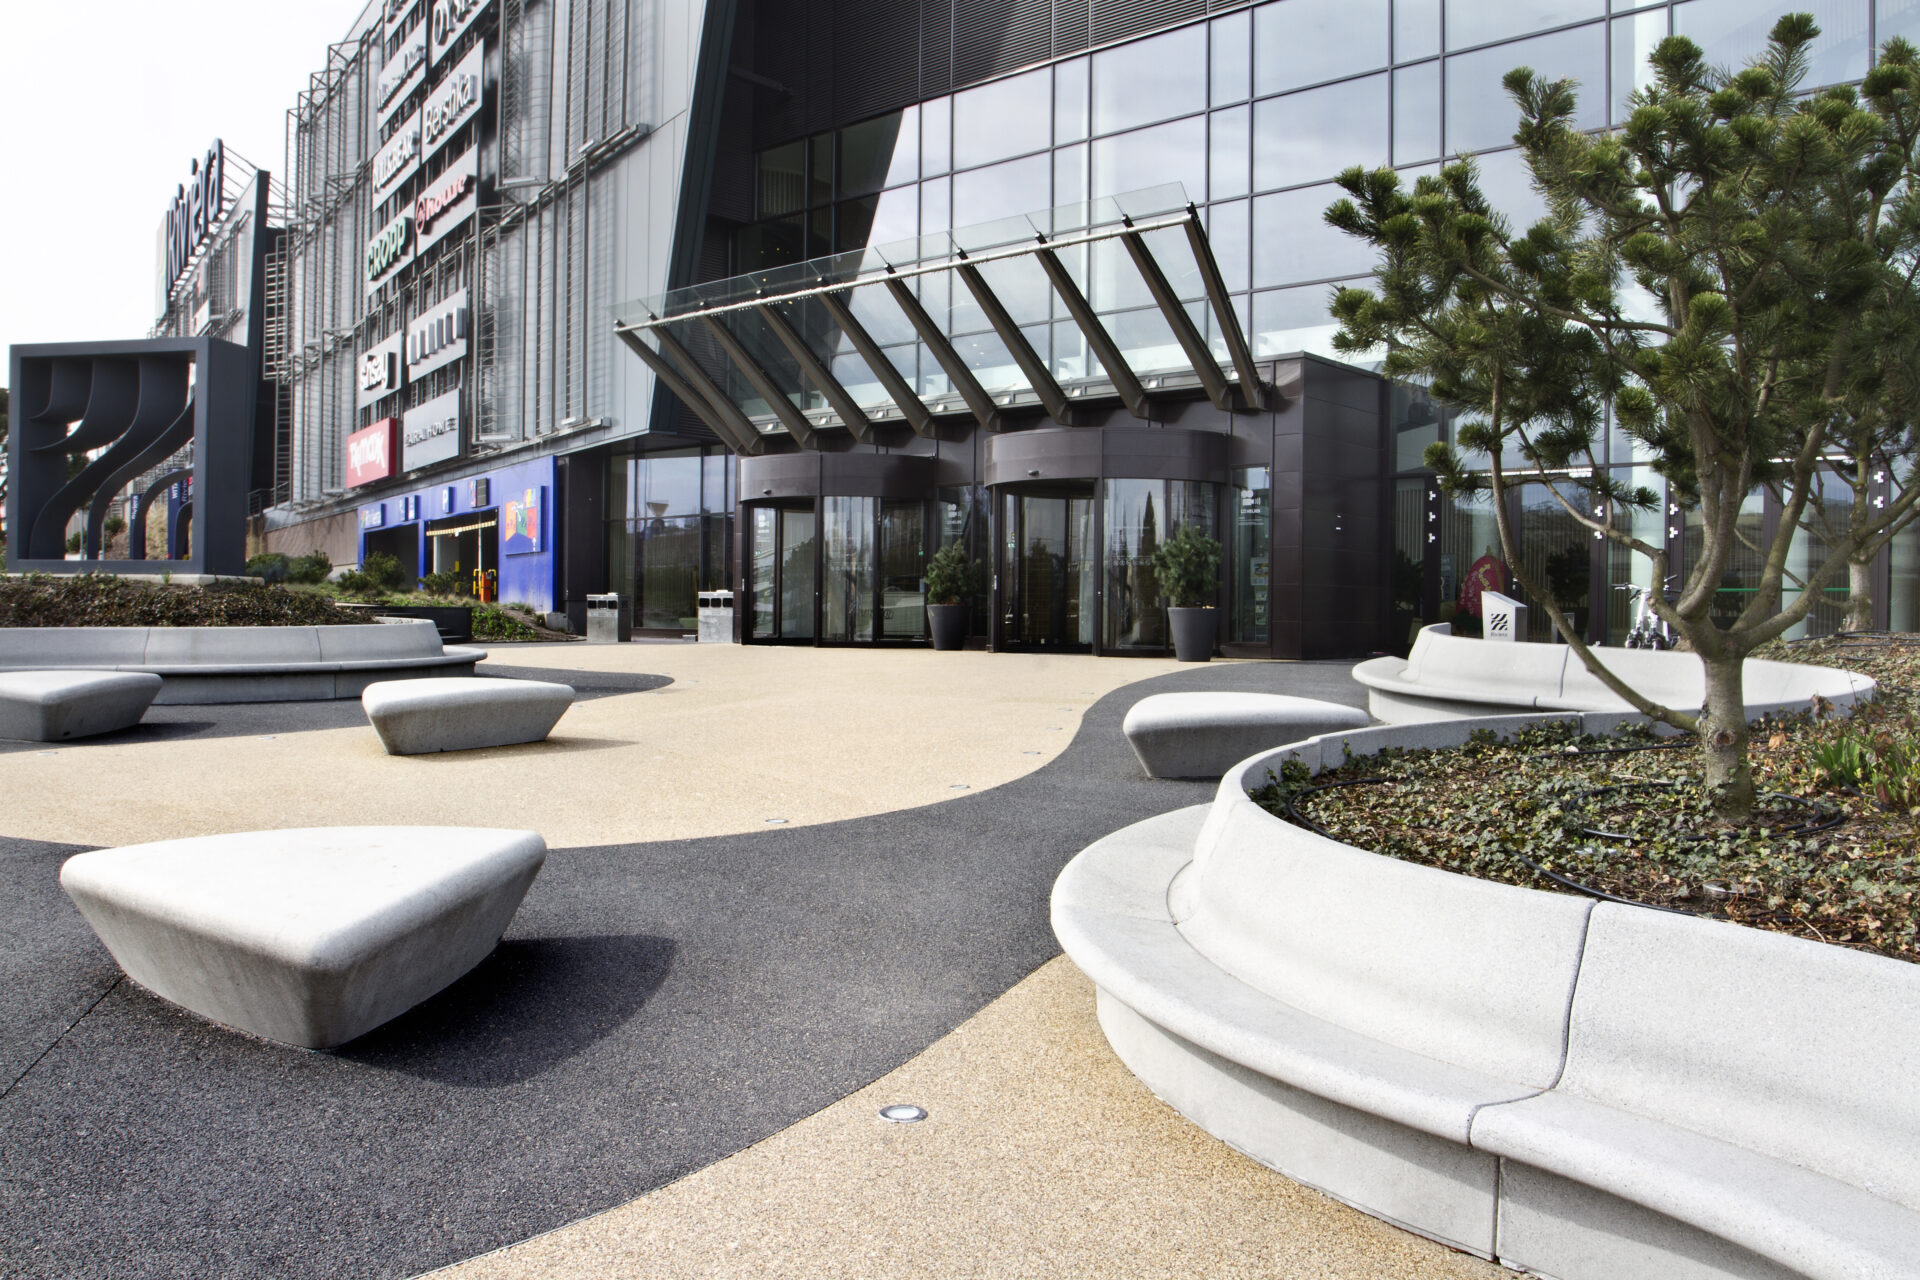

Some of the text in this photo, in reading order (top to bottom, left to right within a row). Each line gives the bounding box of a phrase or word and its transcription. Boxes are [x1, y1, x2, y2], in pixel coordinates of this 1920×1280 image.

[426, 73, 473, 144] Bershka
[165, 137, 224, 292] Riviera
[367, 217, 407, 281] CROPP
[360, 351, 390, 391] sinsay
